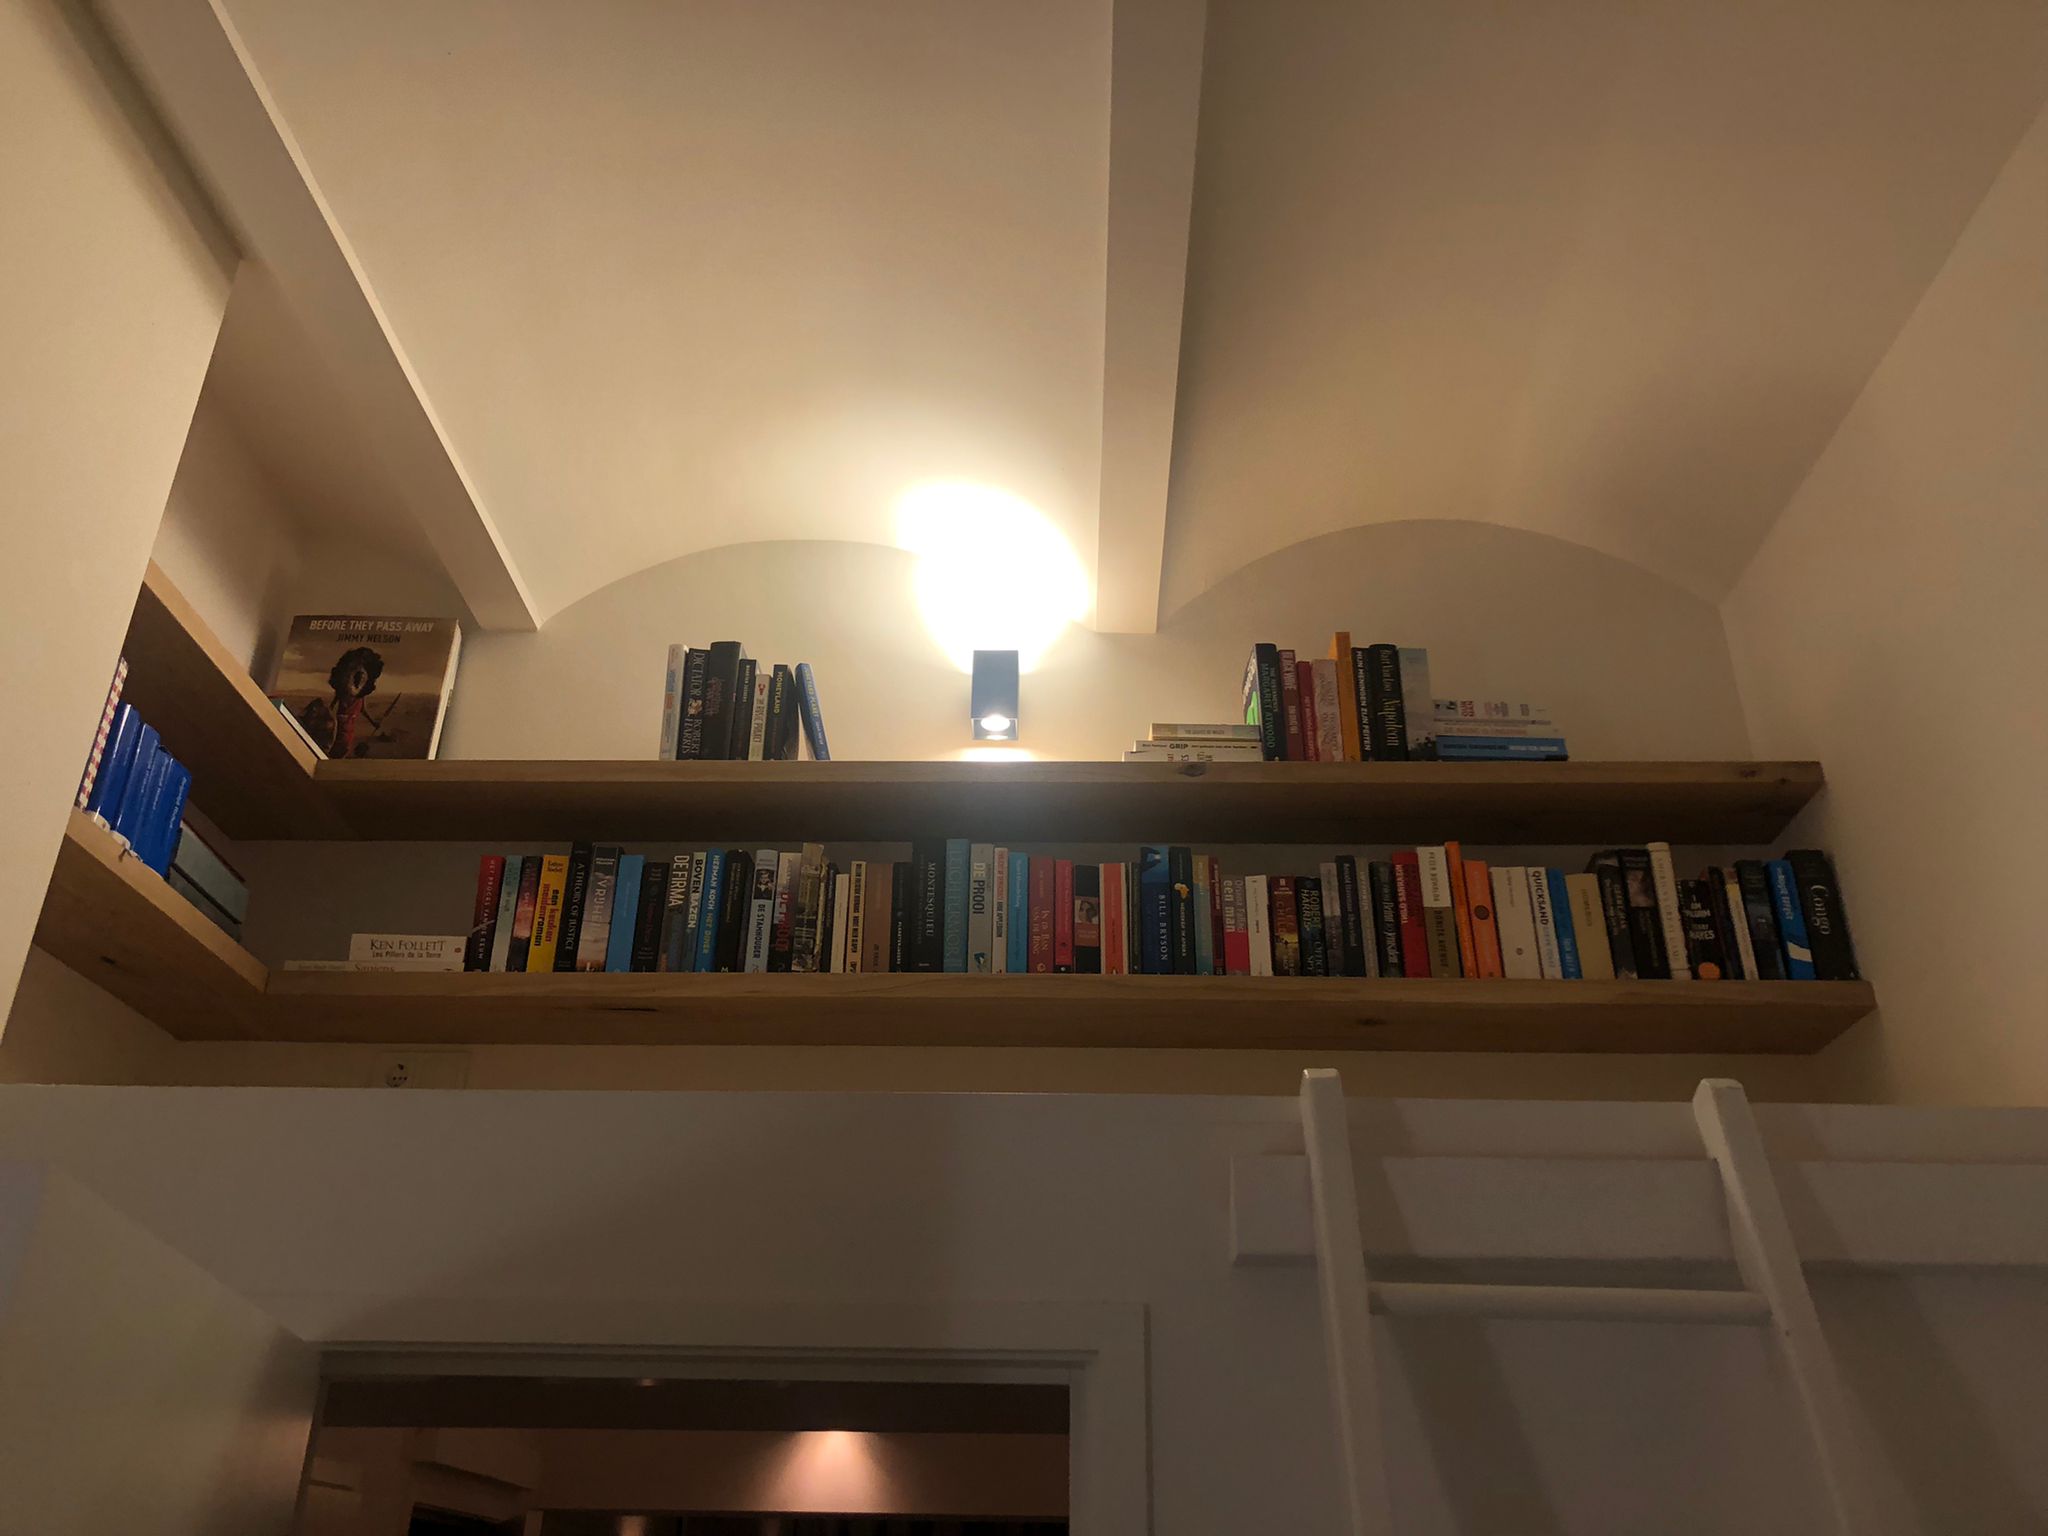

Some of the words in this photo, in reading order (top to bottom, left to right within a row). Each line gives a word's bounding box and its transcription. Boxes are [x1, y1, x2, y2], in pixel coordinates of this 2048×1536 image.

[309, 620, 346, 631] BEFORE
[349, 620, 373, 631] THEY
[376, 621, 402, 632] PASS
[406, 621, 435, 633] AWAY
[336, 632, 364, 643] JIMMY
[367, 633, 402, 644] NELSON
[689, 652, 706, 697] DICTATOR
[1260, 663, 1273, 709] MARGARET
[773, 671, 784, 714] MONEYLAND
[682, 718, 693, 754] HARRIS
[691, 719, 703, 755] ROBERT
[1263, 712, 1276, 748] ATWOOD
[1377, 699, 1403, 747] Napoleon
[673, 855, 690, 870] DE
[709, 855, 720, 887] HERMAN
[974, 862, 986, 877] DE
[571, 870, 585, 904] THEORY
[669, 871, 688, 907] FIRMA
[707, 889, 717, 910] KOCH
[924, 861, 937, 937] MONTESQUIEU
[973, 880, 985, 914] PROOI
[1223, 880, 1233, 902] een
[1532, 871, 1549, 925] QUICKSAND
[568, 905, 577, 918] OF
[757, 904, 766, 913] DE
[1158, 894, 1166, 918] BILL
[1225, 906, 1236, 933] man
[1237, 909, 1247, 934] Fallaci
[1300, 888, 1312, 929] HARRIS
[1309, 889, 1321, 929] ROBERT
[1811, 884, 1832, 935] Congo
[370, 939, 395, 952] KEN
[398, 940, 447, 953] FOLLETT
[565, 918, 577, 951] JUSTICE
[753, 913, 764, 959] STAMHOUDER
[1159, 922, 1169, 961] BRYSON
